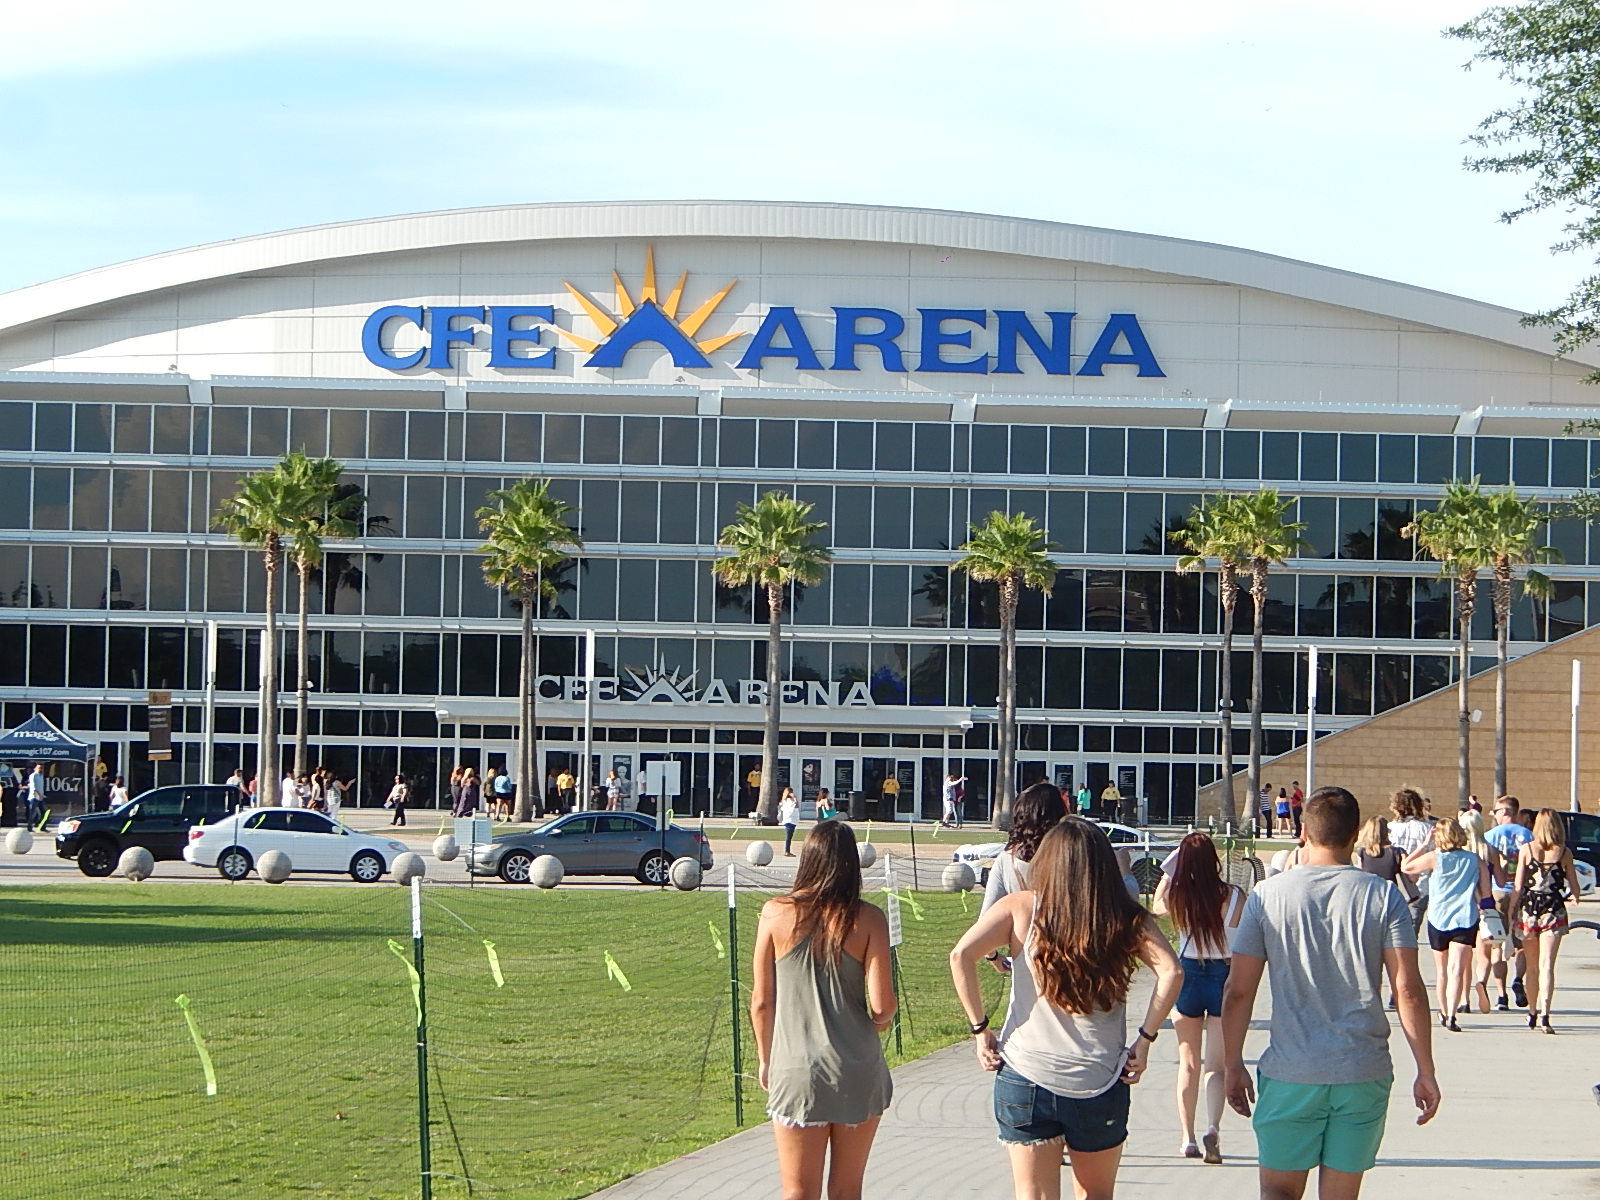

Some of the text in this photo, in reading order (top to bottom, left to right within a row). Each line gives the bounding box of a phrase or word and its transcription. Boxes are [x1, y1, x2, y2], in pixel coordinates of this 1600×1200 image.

[362, 305, 1168, 378] CFE ARENA
[534, 675, 877, 708] CFE ARENA
[13, 730, 61, 741] magic
[45, 776, 82, 792] 106.7
